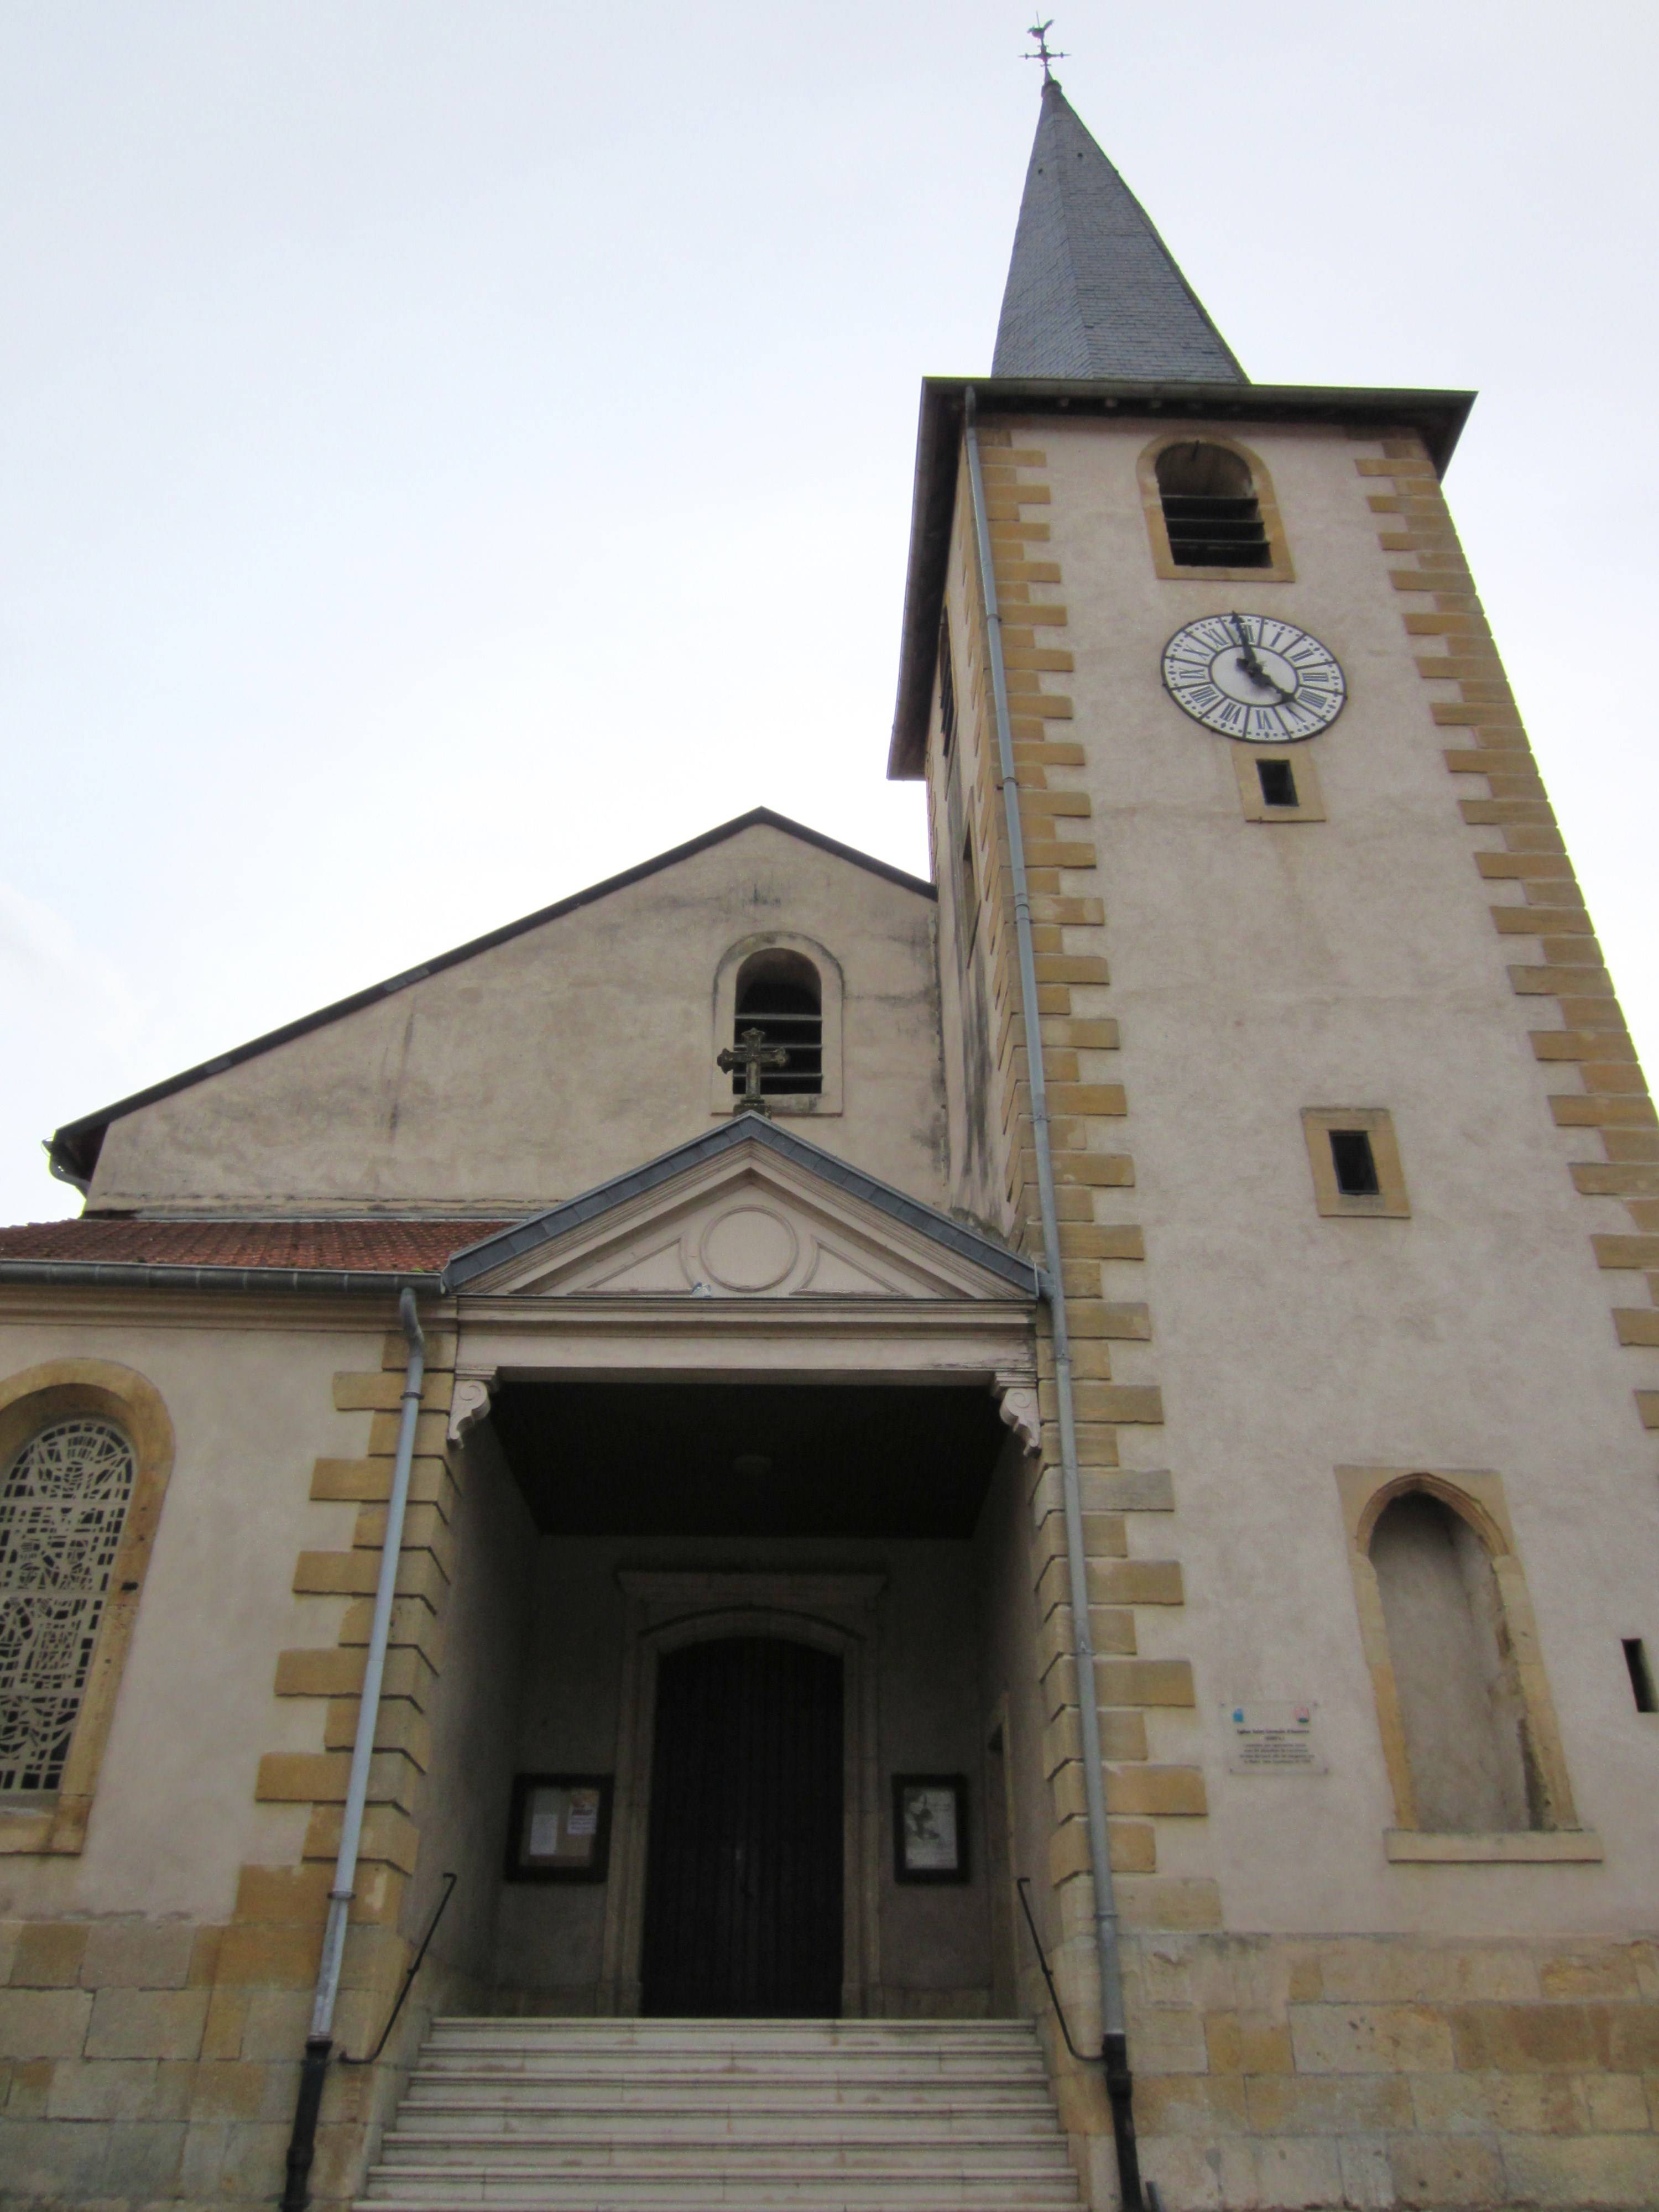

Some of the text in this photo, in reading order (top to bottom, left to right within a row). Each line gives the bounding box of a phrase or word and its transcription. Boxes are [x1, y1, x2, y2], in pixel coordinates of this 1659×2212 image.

[1202, 628, 1228, 648] XI
[1182, 644, 1210, 661] X
[1291, 648, 1314, 662] II
[1179, 667, 1205, 679] IX
[1302, 672, 1329, 683] III
